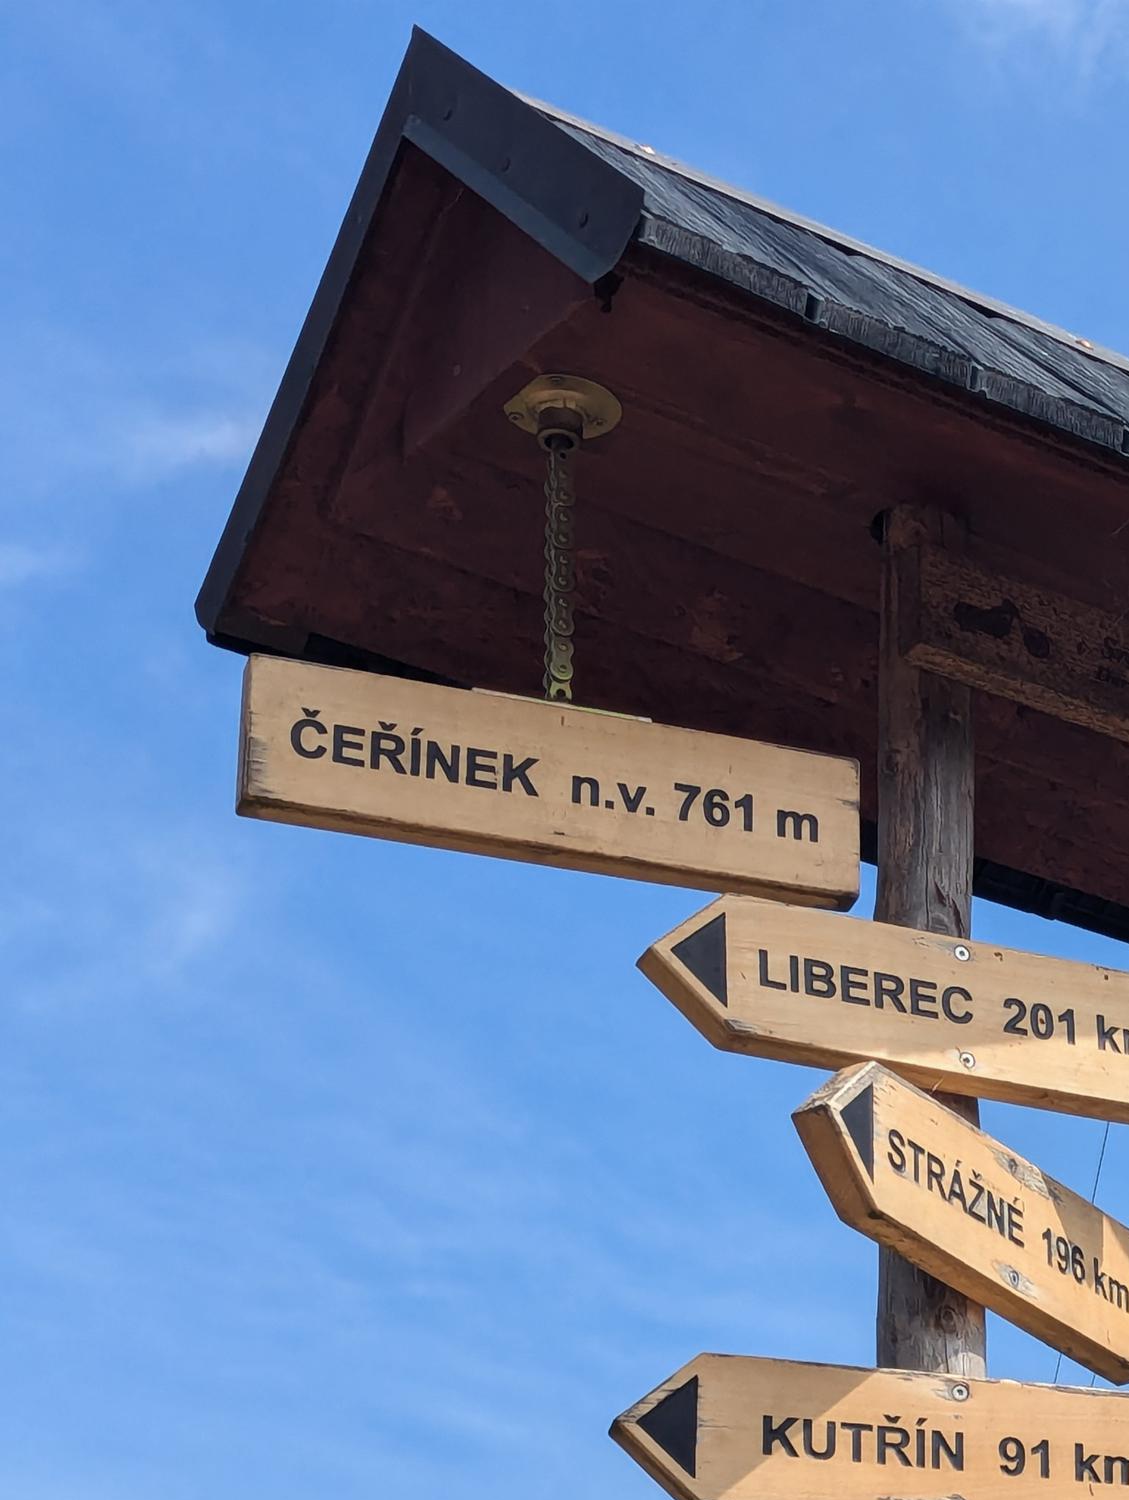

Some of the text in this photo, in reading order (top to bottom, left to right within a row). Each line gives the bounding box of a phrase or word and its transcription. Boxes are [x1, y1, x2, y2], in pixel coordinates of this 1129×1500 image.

[290, 708, 819, 843] ČEŘÍNEK n.v. 761 m
[759, 949, 973, 1024] LIBEREC
[1003, 998, 1076, 1044] 201
[888, 1130, 1024, 1248] STRÁŽNÉ
[1041, 1228, 1084, 1284] 196
[762, 1415, 964, 1471] KUTŘÍN
[999, 1436, 1050, 1479] 91
